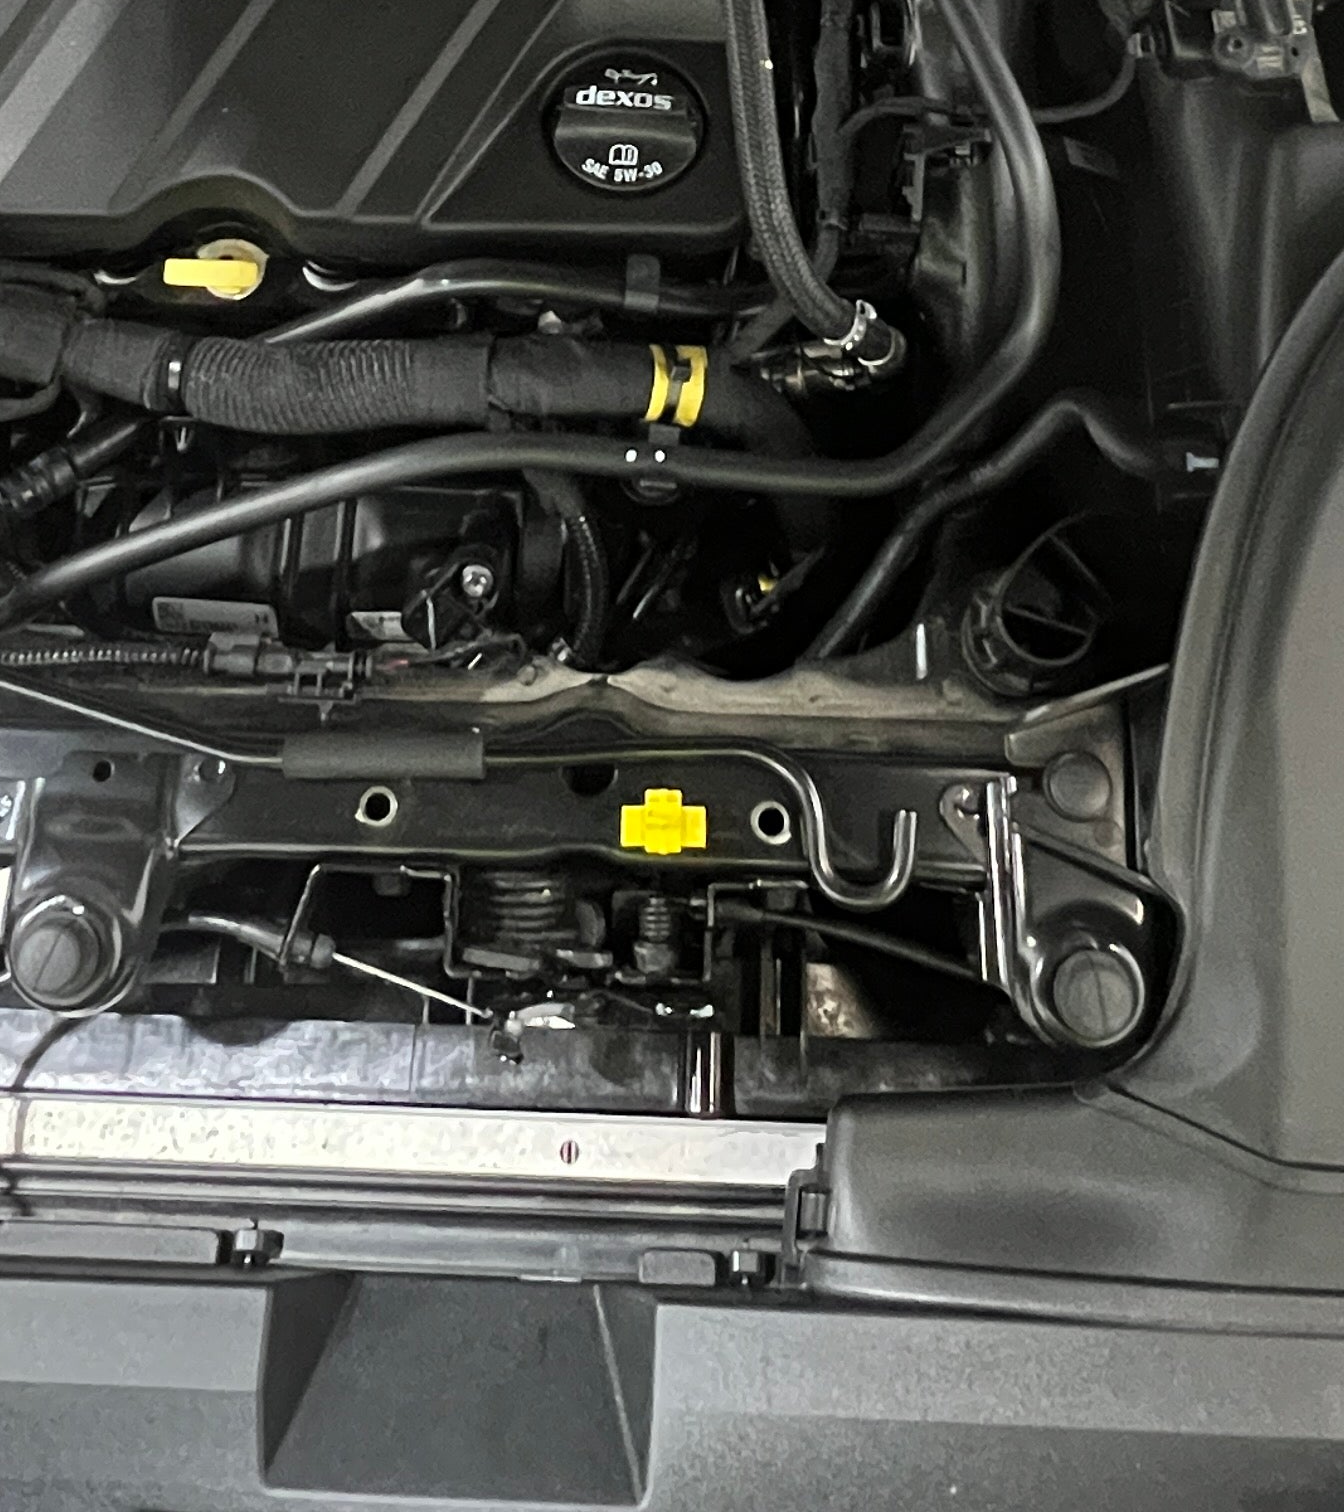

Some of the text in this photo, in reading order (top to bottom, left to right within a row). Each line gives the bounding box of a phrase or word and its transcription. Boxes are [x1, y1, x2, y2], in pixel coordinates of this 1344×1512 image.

[576, 85, 673, 110] dexos
[582, 159, 663, 182] SAE 5W-30
